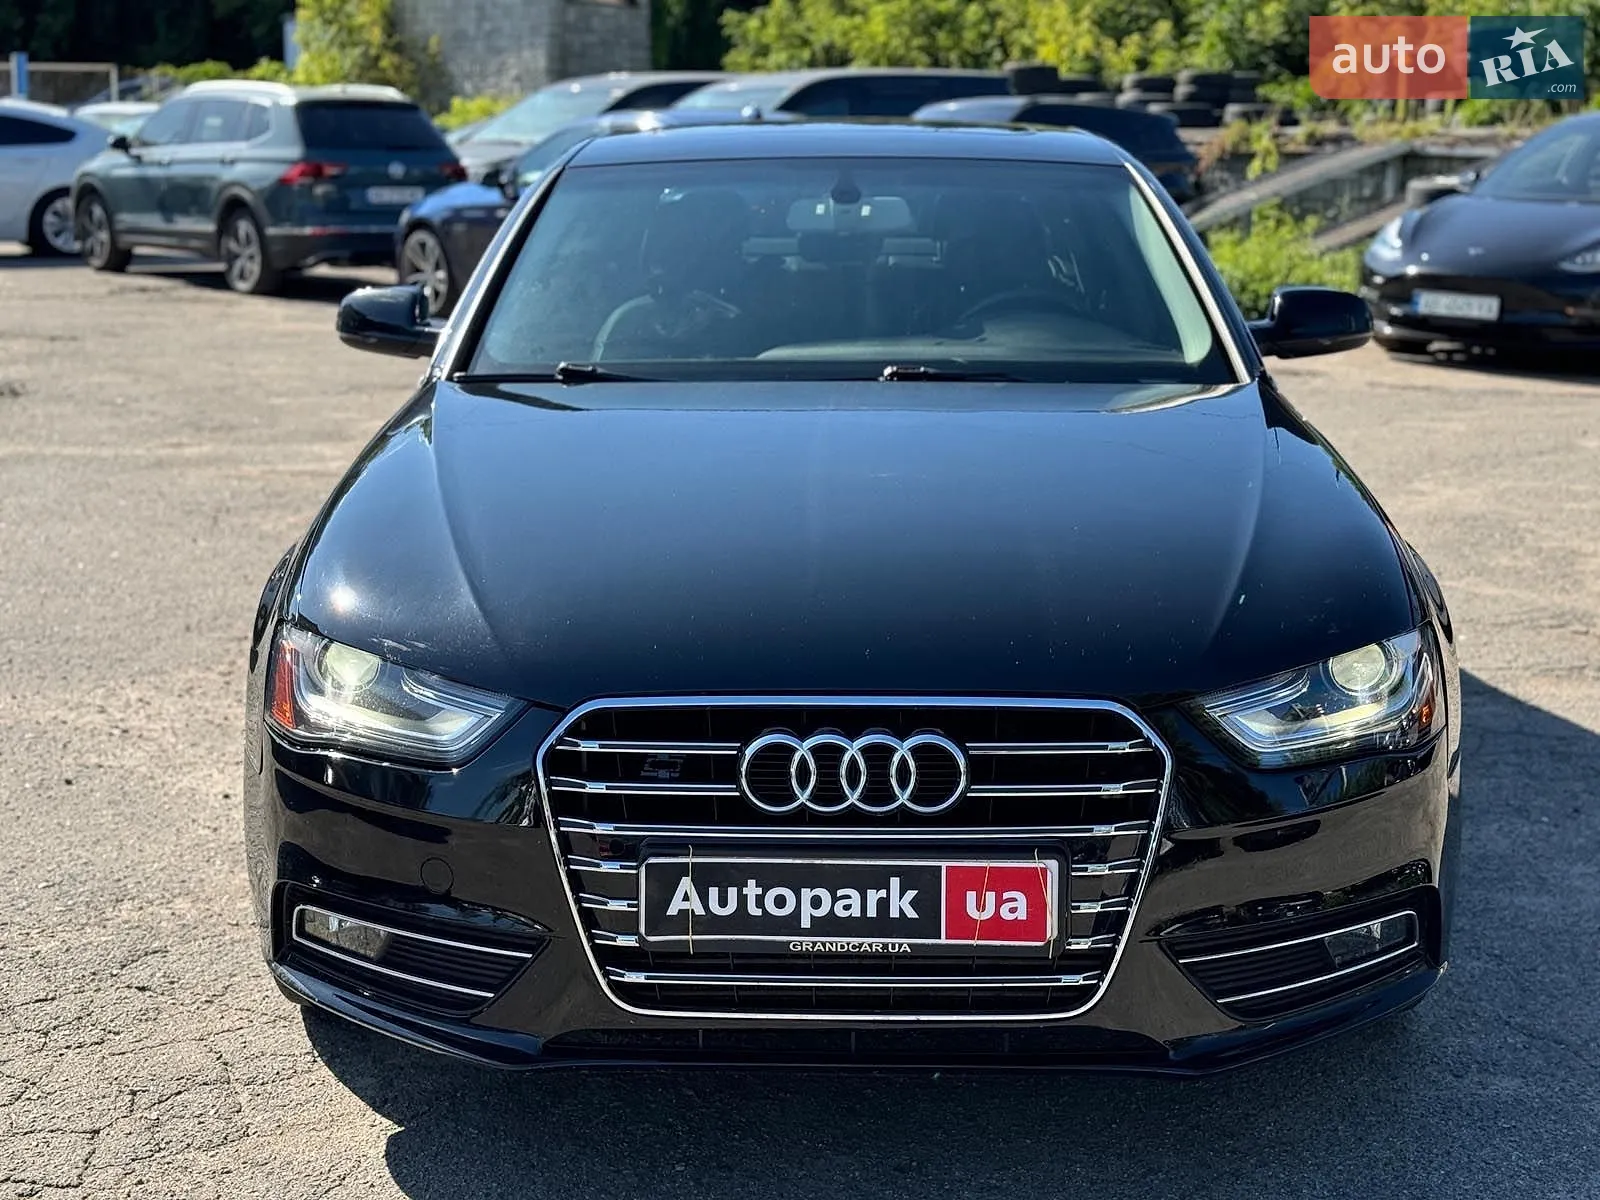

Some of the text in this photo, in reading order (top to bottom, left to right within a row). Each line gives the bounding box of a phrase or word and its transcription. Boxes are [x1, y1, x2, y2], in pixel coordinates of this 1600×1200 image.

[666, 876, 1027, 928] Autopark ua
[789, 942, 911, 953] GRANDCAR.UA
